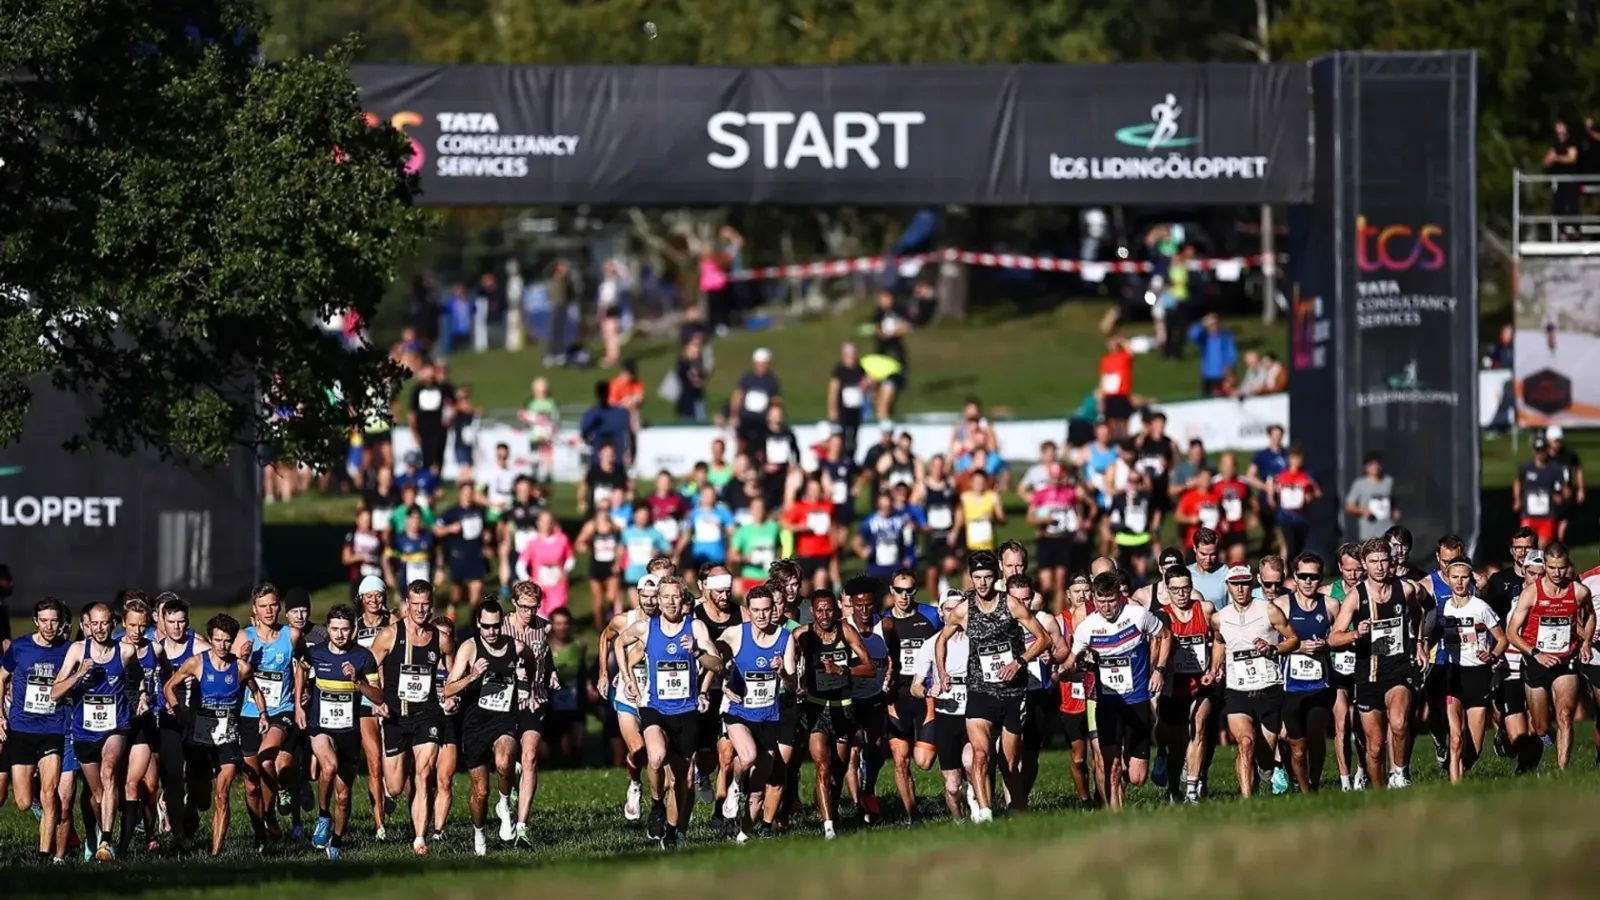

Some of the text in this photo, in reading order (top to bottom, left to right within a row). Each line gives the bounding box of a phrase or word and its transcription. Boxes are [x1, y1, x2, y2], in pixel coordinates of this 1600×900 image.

[437, 112, 499, 133] TATA
[437, 134, 579, 157] CONSULTANCY
[707, 111, 926, 170] START
[437, 156, 528, 178] SERVICES
[1050, 152, 1267, 180] tcs LIDINGÖLOPPET
[1355, 214, 1446, 272] tcs
[1356, 280, 1400, 296] TATA
[1356, 295, 1458, 313] CONSULTANCY
[1356, 311, 1422, 328] SERVICES
[1246, 666, 1257, 676] 13
[1299, 660, 1314, 669] 195
[666, 678, 682, 688] 166
[1108, 674, 1124, 683] 110
[952, 692, 966, 701] 121
[92, 712, 108, 721] 162
[329, 708, 344, 717] 153
